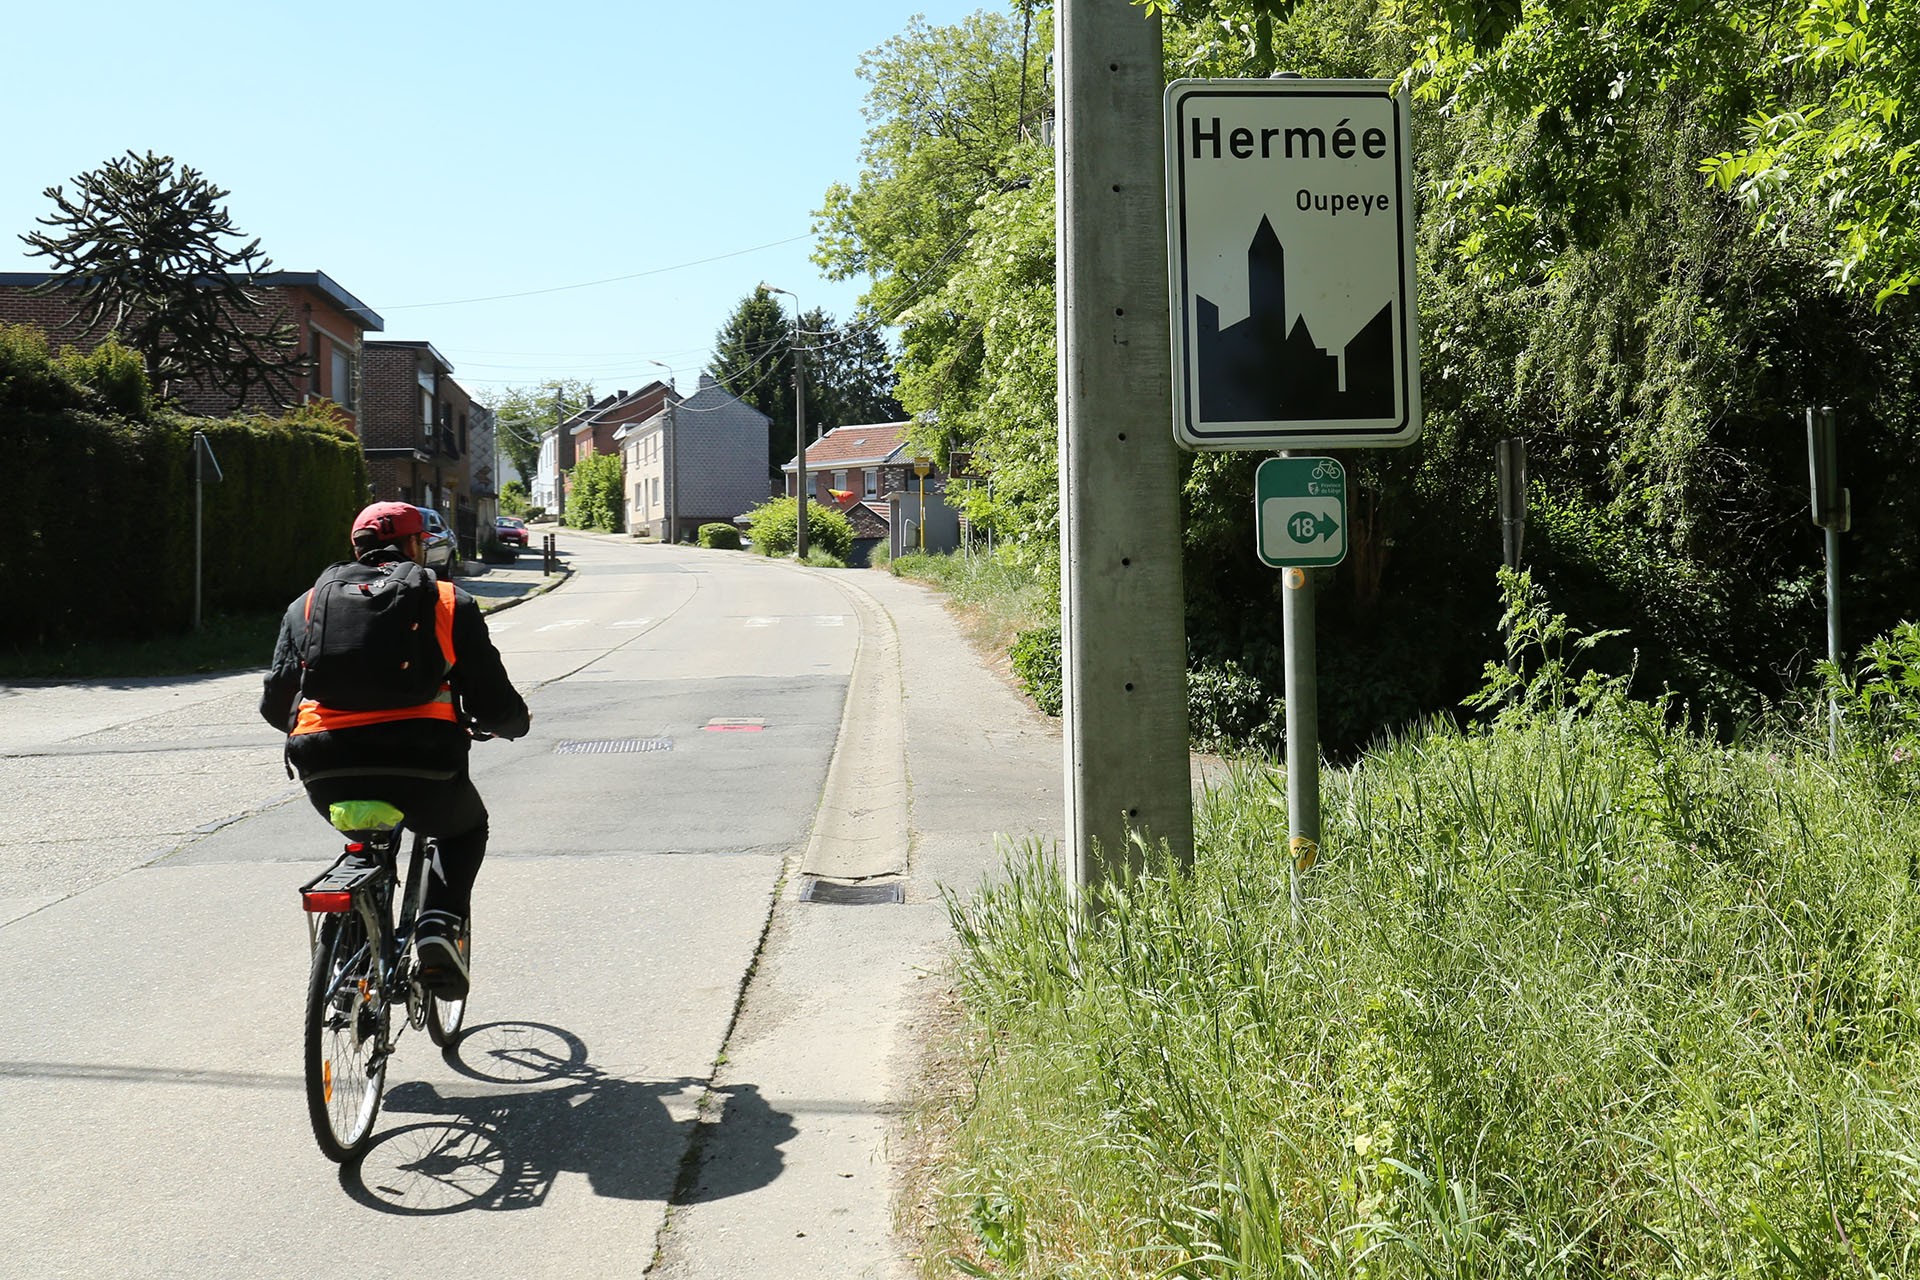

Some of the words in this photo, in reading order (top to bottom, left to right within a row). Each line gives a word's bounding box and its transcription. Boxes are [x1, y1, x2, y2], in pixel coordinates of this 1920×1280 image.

[1191, 117, 1386, 160] Hermée
[1296, 189, 1389, 216] Oupeye
[1292, 518, 1315, 537] 18
